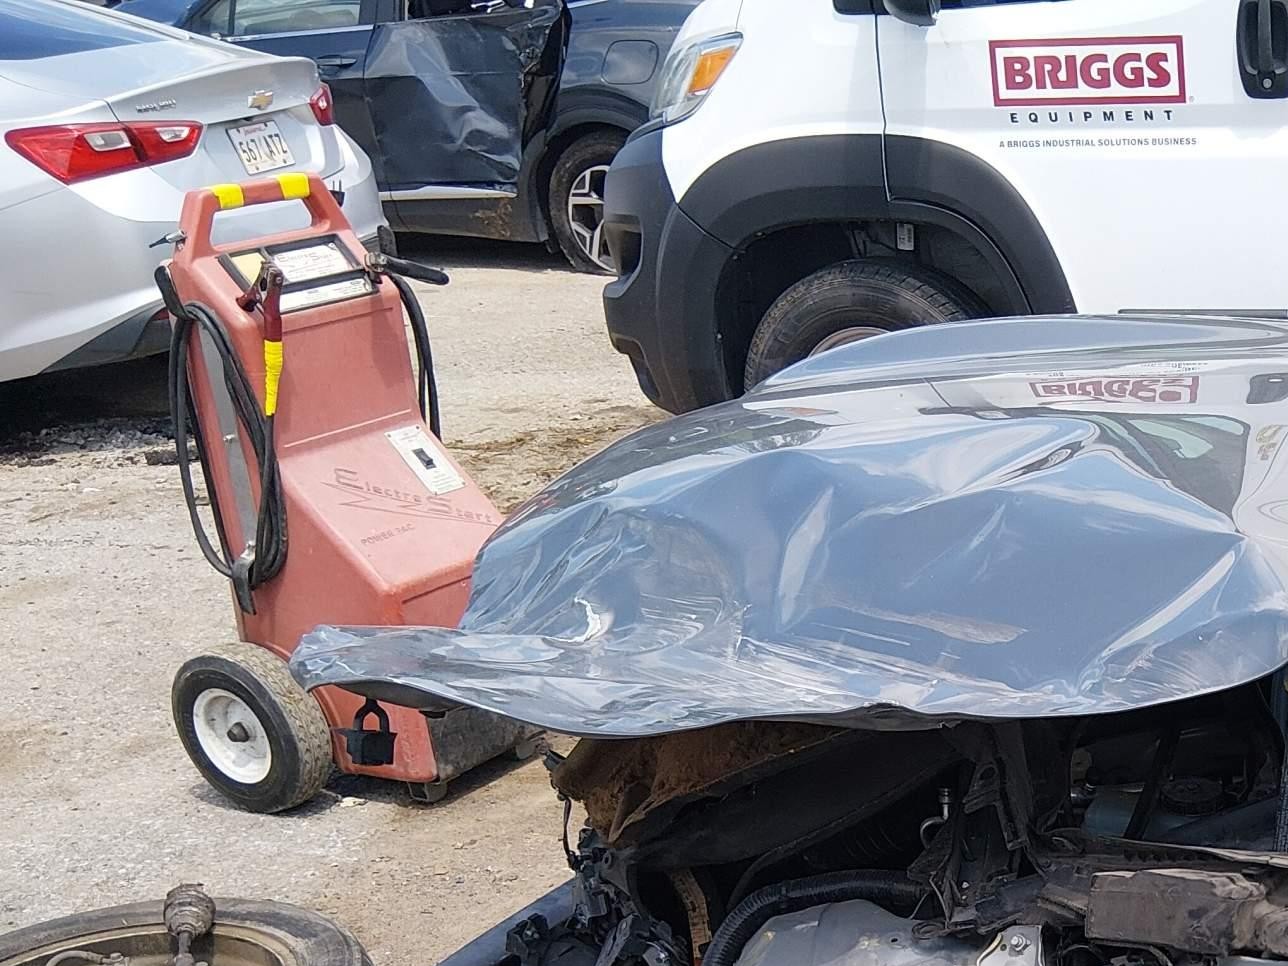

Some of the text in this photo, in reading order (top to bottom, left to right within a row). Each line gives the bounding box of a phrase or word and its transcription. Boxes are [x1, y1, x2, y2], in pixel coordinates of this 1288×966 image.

[1003, 52, 1172, 90] BRIGGS
[1009, 109, 1173, 124] EQUIPMENT
[999, 137, 1198, 148] A BRIGGS INDUSTRIAL SOLUTIONS BUSINESS
